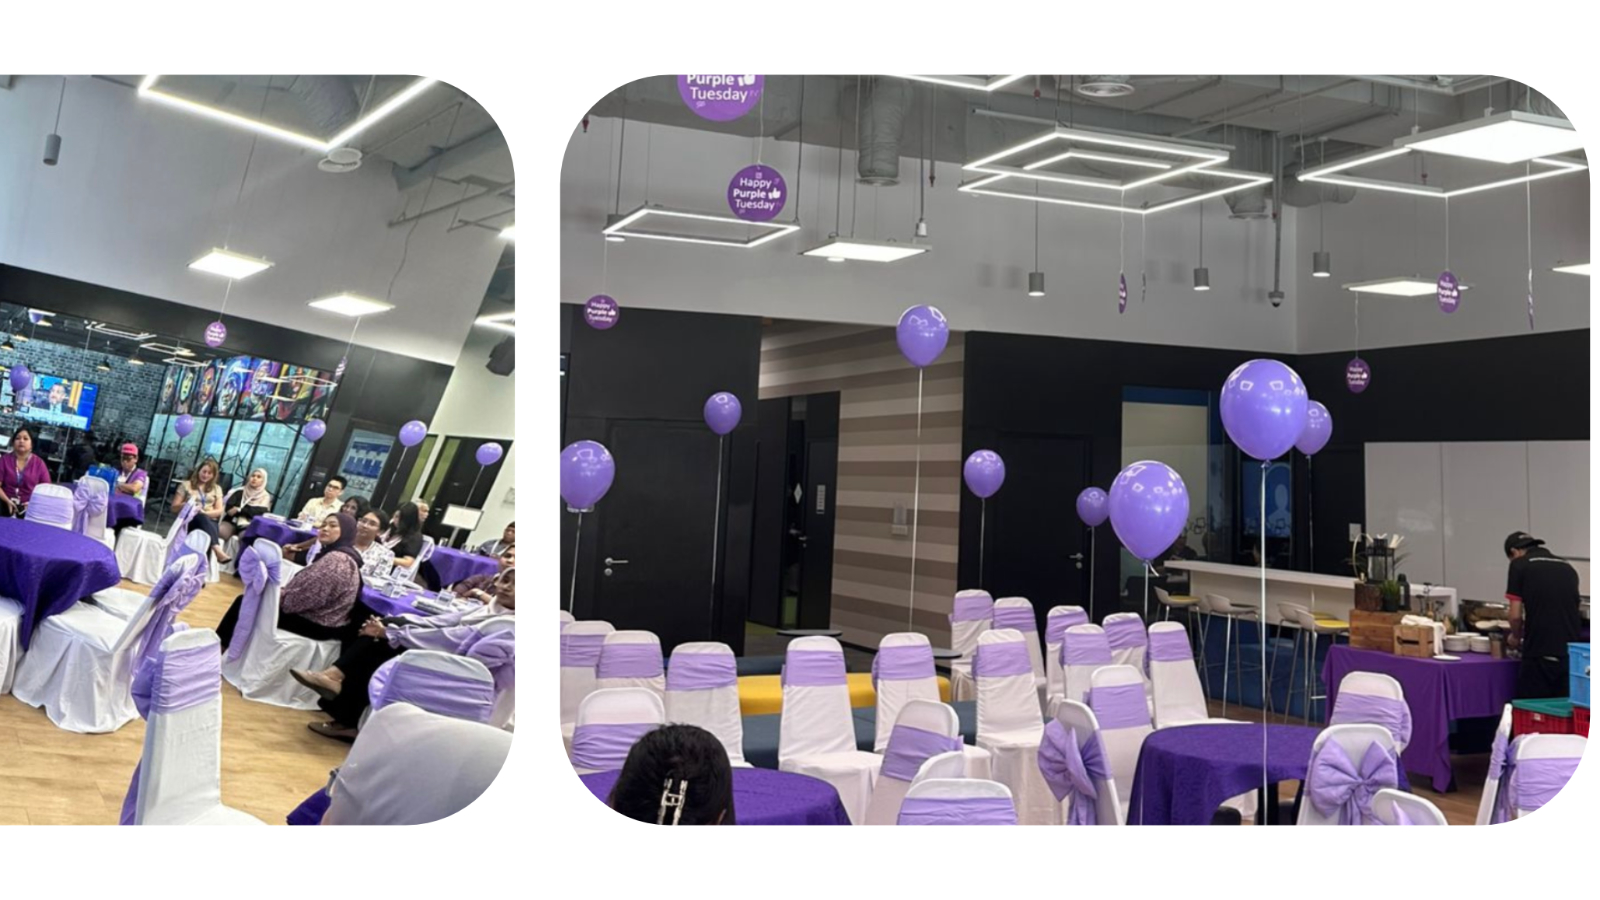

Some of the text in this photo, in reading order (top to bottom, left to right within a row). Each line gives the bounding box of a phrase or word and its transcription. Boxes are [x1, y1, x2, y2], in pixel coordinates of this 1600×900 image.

[687, 74, 735, 88] Purple
[689, 87, 748, 104] Tuesday
[740, 177, 772, 190] Happy
[733, 188, 767, 200] Purple
[735, 199, 775, 211] Tuesday
